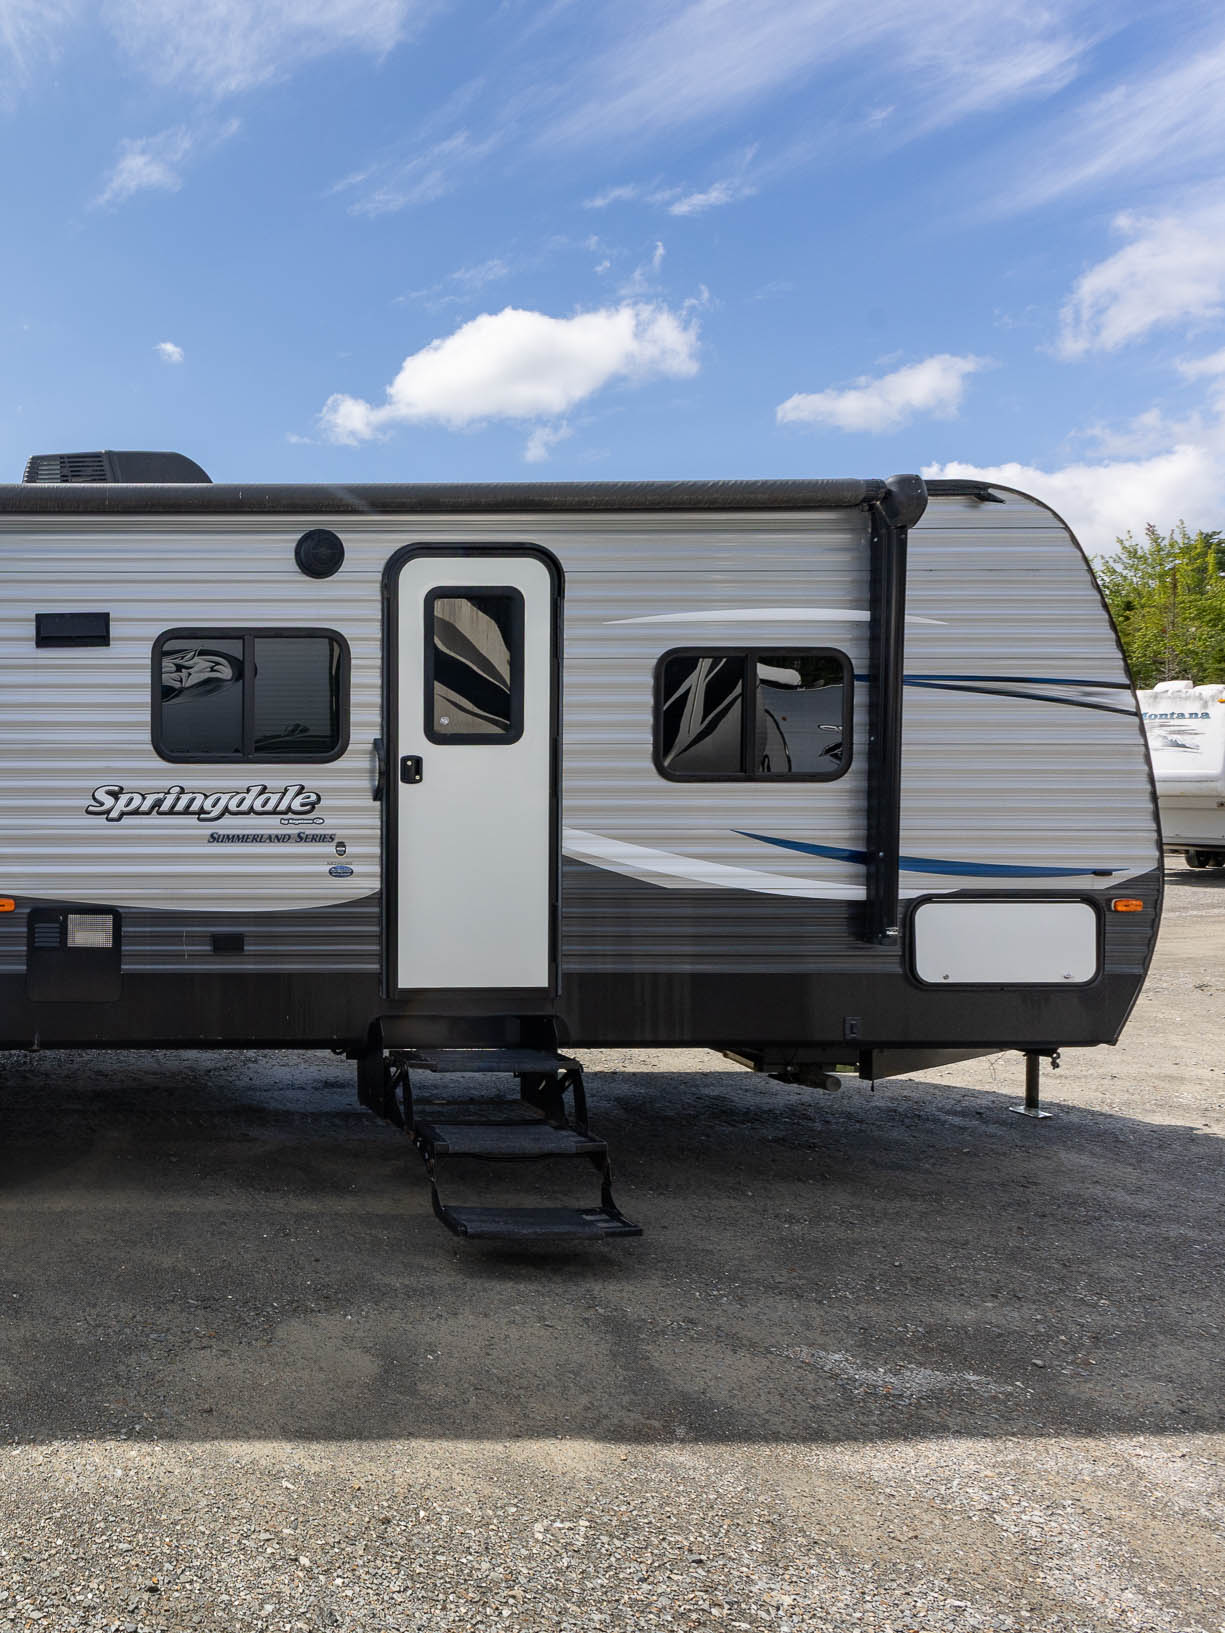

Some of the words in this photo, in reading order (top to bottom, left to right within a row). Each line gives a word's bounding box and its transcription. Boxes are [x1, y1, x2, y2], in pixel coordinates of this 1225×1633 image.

[85, 784, 321, 822] Springdale
[207, 831, 292, 844] SUMMERLAND
[294, 831, 336, 844] SERIES
